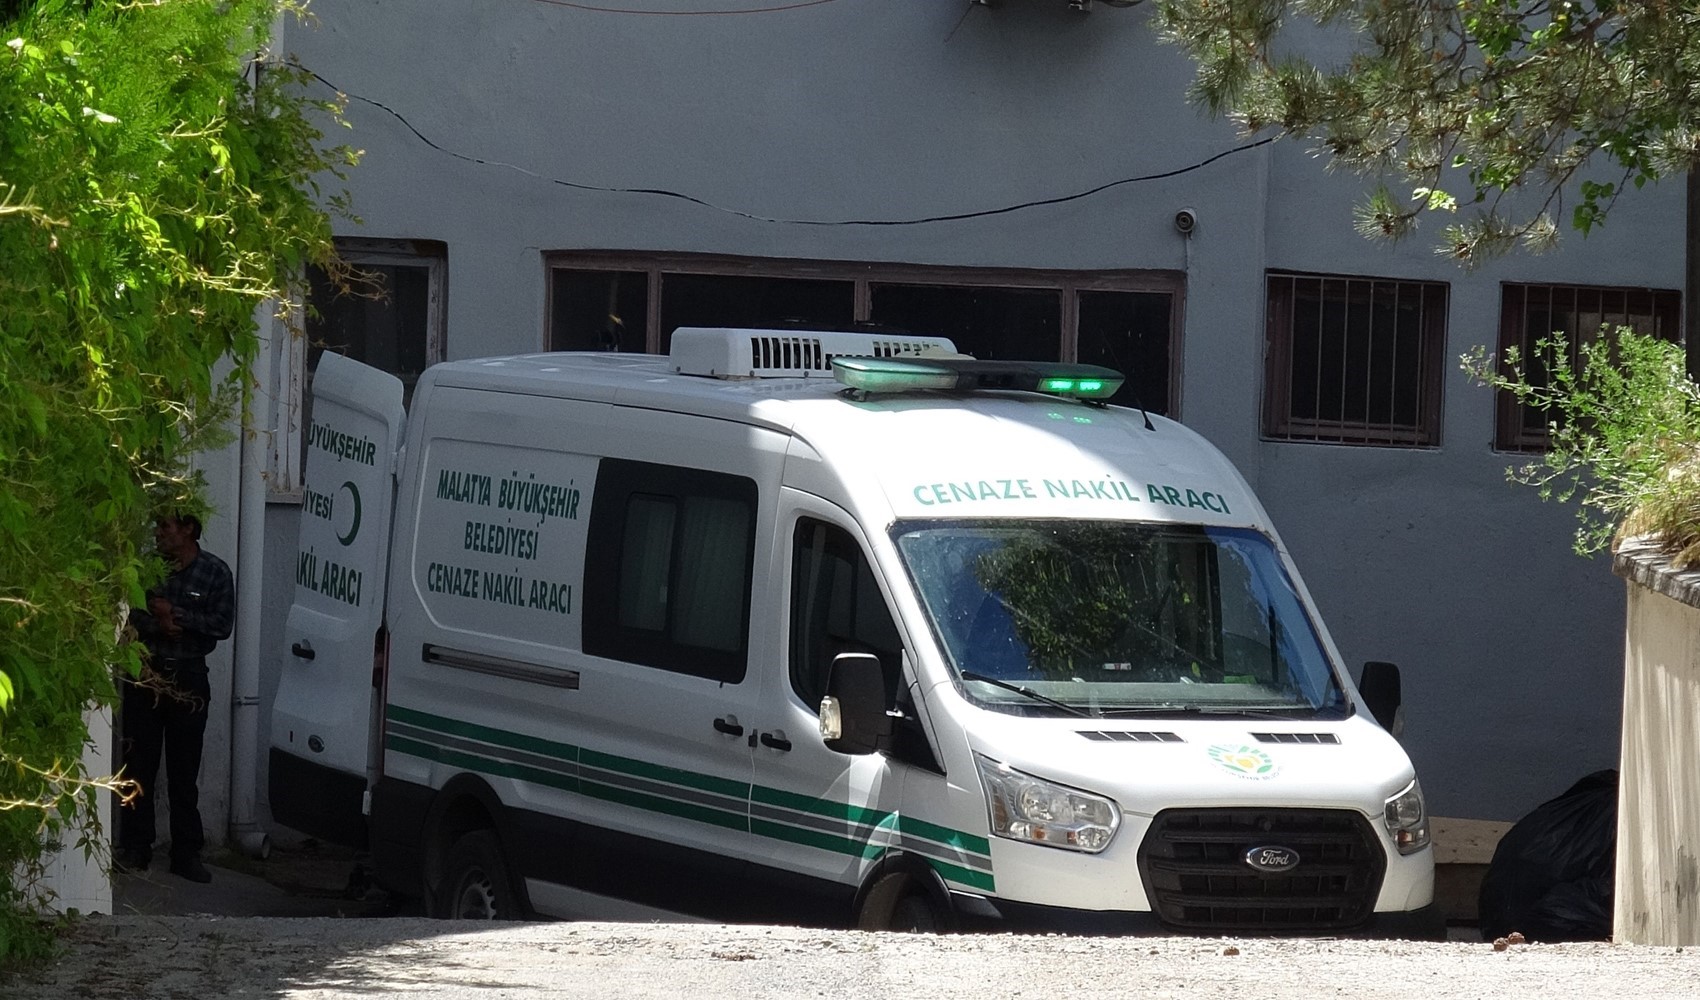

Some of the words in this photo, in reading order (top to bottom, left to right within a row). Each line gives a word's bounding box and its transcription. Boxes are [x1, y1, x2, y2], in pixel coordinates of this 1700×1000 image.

[303, 484, 334, 521] İYESİ
[437, 469, 491, 506] MALATYA
[498, 471, 580, 524] BÜYÜKŞEHİR
[913, 479, 1038, 506] CENAZE
[1043, 474, 1140, 502] NAKİL
[1146, 483, 1231, 515] ARACI
[464, 517, 539, 560] BELEDİYESİ
[321, 560, 362, 607] ARACI
[427, 562, 479, 599] CENAZE
[482, 567, 525, 607] NAKİL
[528, 579, 572, 614] ARACI
[1260, 849, 1289, 865] Ford
